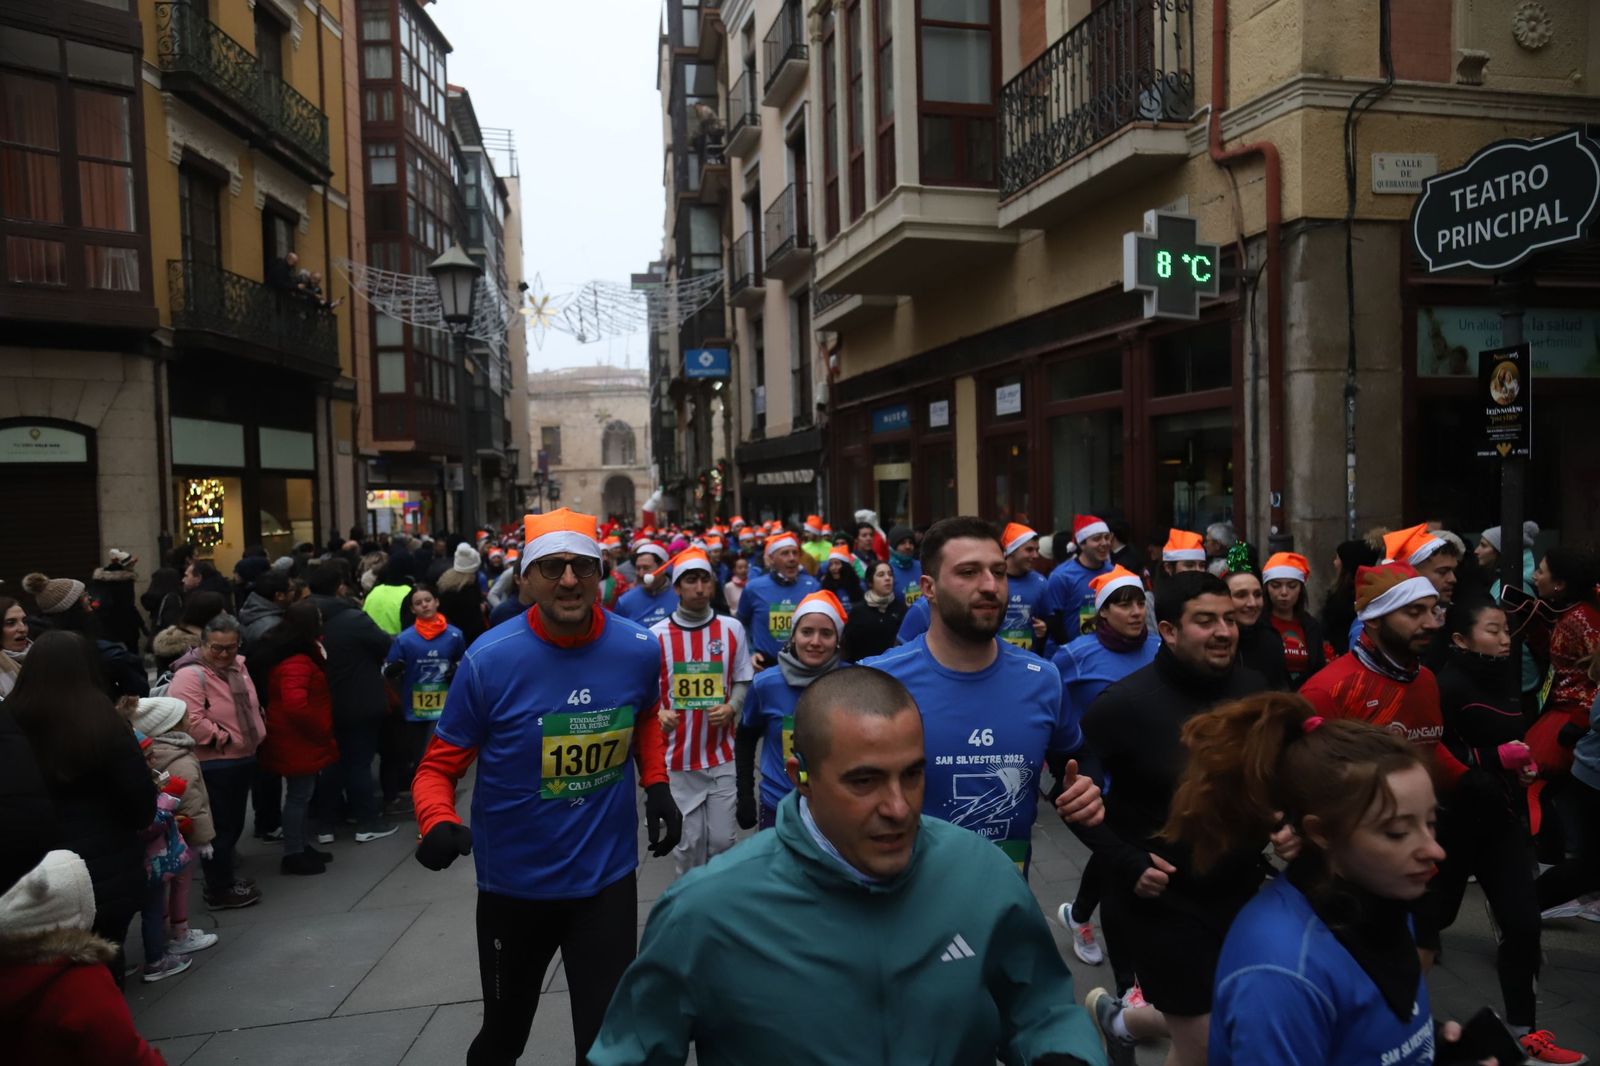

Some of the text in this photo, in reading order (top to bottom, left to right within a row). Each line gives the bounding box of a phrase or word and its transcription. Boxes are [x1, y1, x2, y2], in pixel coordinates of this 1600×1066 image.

[1395, 159, 1423, 168] CALLE
[1400, 170, 1412, 178] DE
[1450, 164, 1549, 213] TEATRO
[1438, 199, 1569, 253] PRINCIPAL
[1157, 250, 1212, 282] 8 °C
[1532, 317, 1544, 332] la
[1547, 316, 1583, 332] salud
[1485, 335, 1501, 348] de
[679, 678, 715, 697] 818
[417, 693, 442, 708] 121
[567, 688, 592, 706] 46
[569, 719, 609, 731] CAJA RURAL
[967, 728, 995, 747] 46
[549, 739, 620, 777] 1307
[935, 753, 1025, 766] SAN SILVESTRE 2025
[568, 780, 592, 792] CAJA
